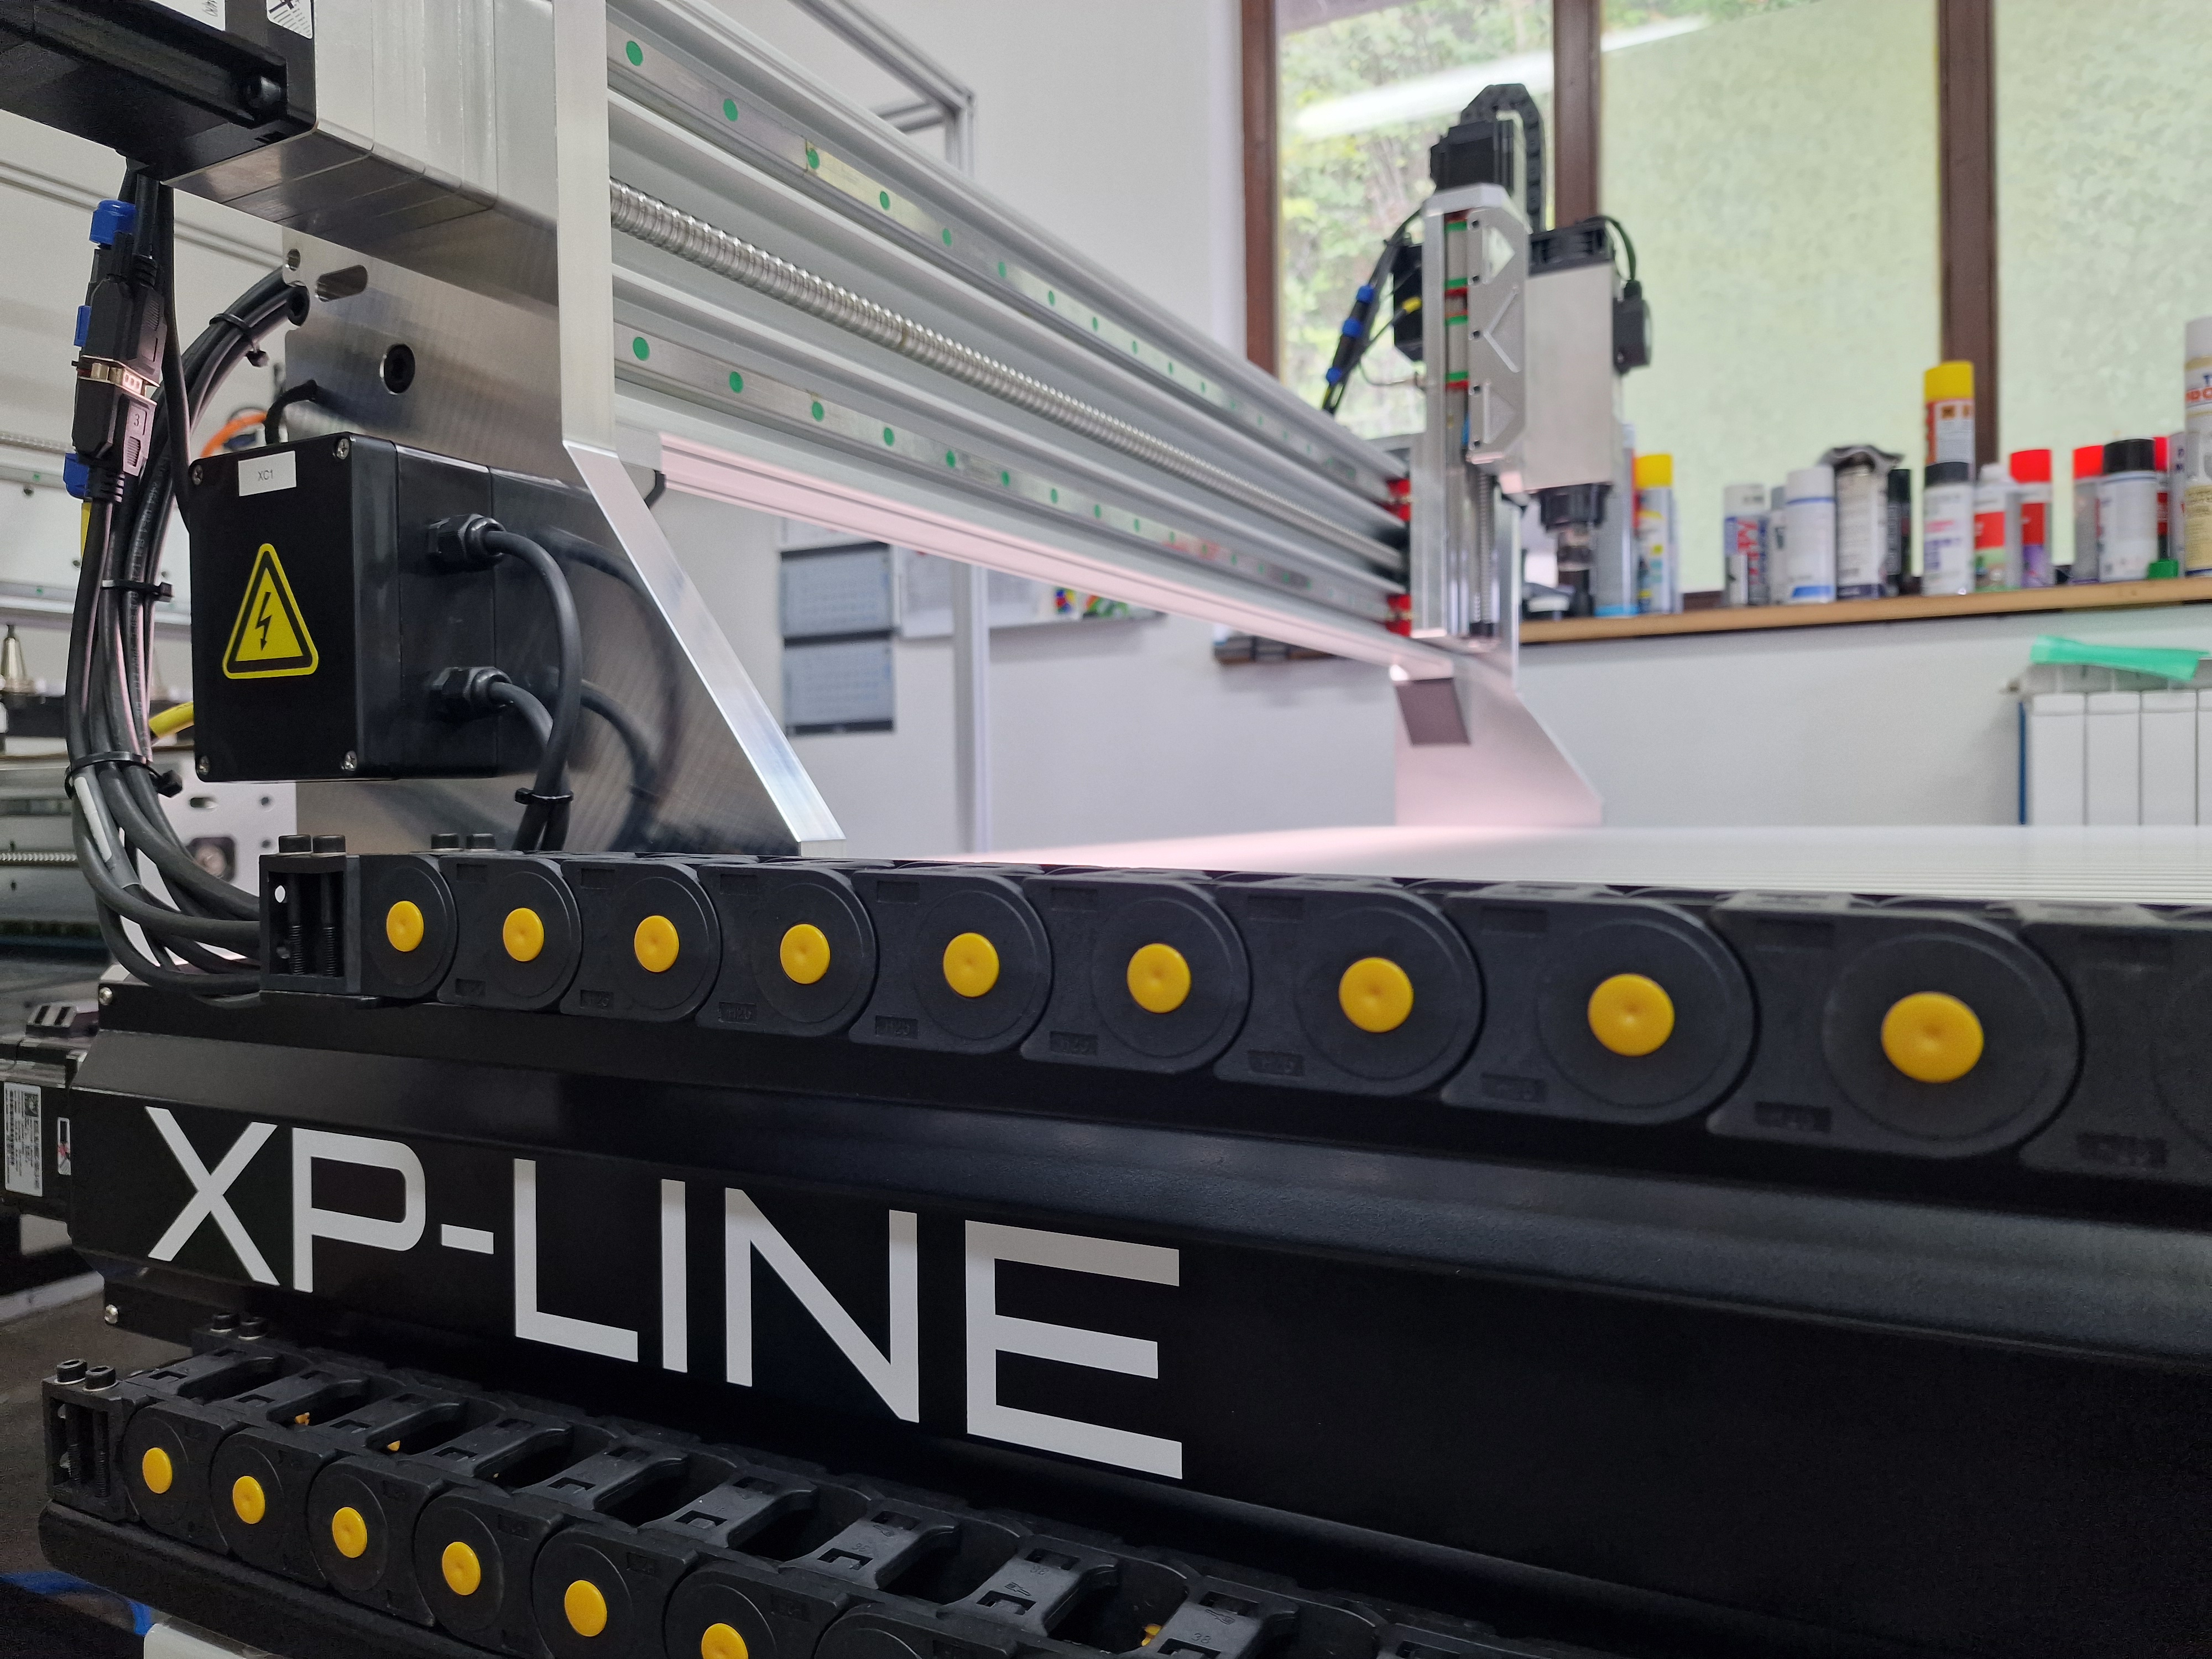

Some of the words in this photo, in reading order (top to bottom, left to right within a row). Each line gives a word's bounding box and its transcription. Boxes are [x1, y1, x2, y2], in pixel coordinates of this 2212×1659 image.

[134, 414, 140, 427] 3
[258, 469, 273, 481] XC1
[145, 1106, 1182, 1480] XP-LINE
[1191, 1633, 1212, 1644] 38
